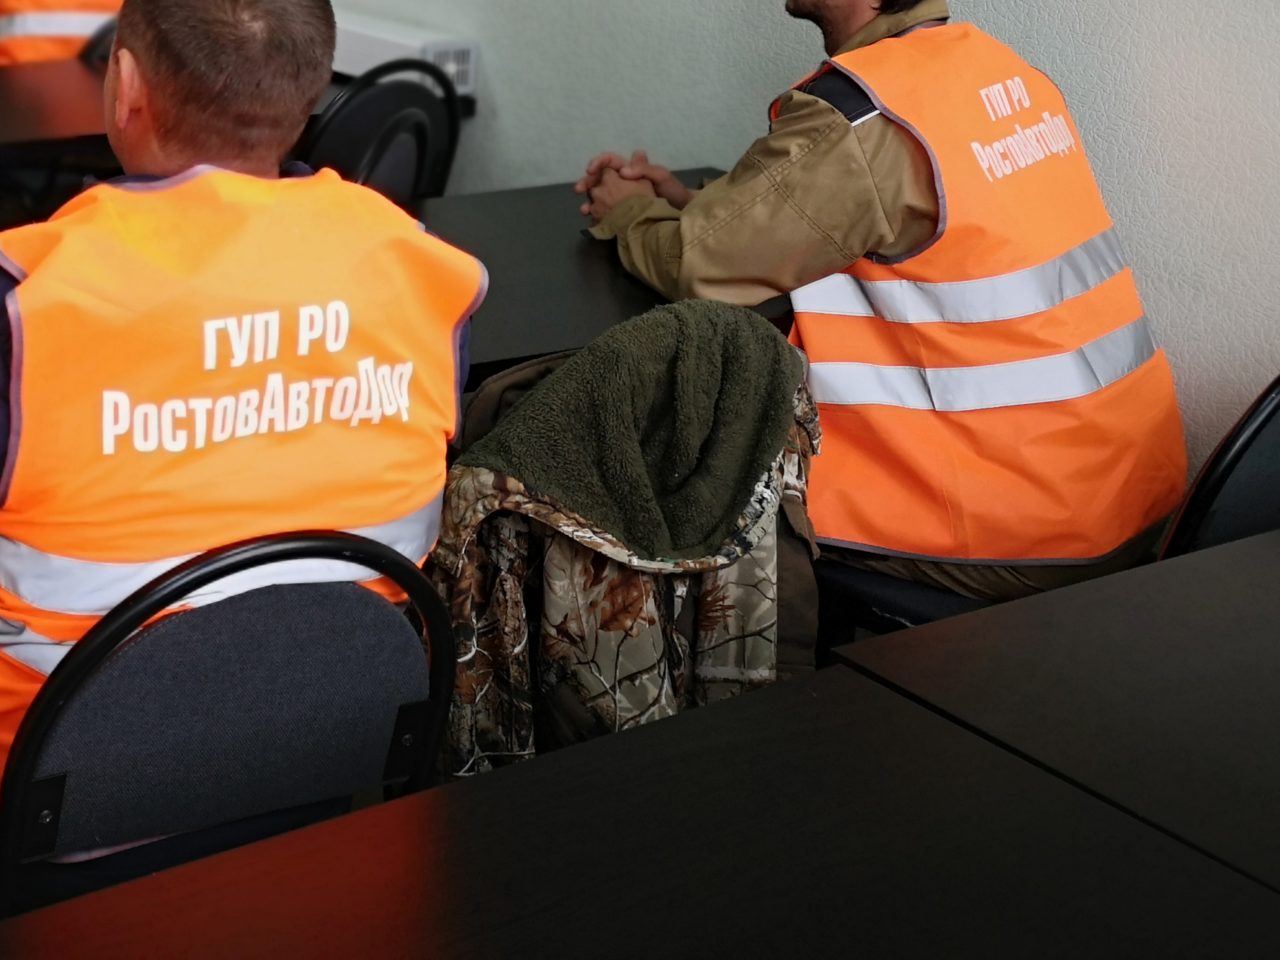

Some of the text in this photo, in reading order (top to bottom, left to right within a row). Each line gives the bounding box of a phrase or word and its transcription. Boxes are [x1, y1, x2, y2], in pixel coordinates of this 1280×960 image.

[979, 76, 1031, 121] ГУП РО
[203, 300, 350, 371] ГУП РО
[102, 356, 414, 455] РостовАвтоДор
